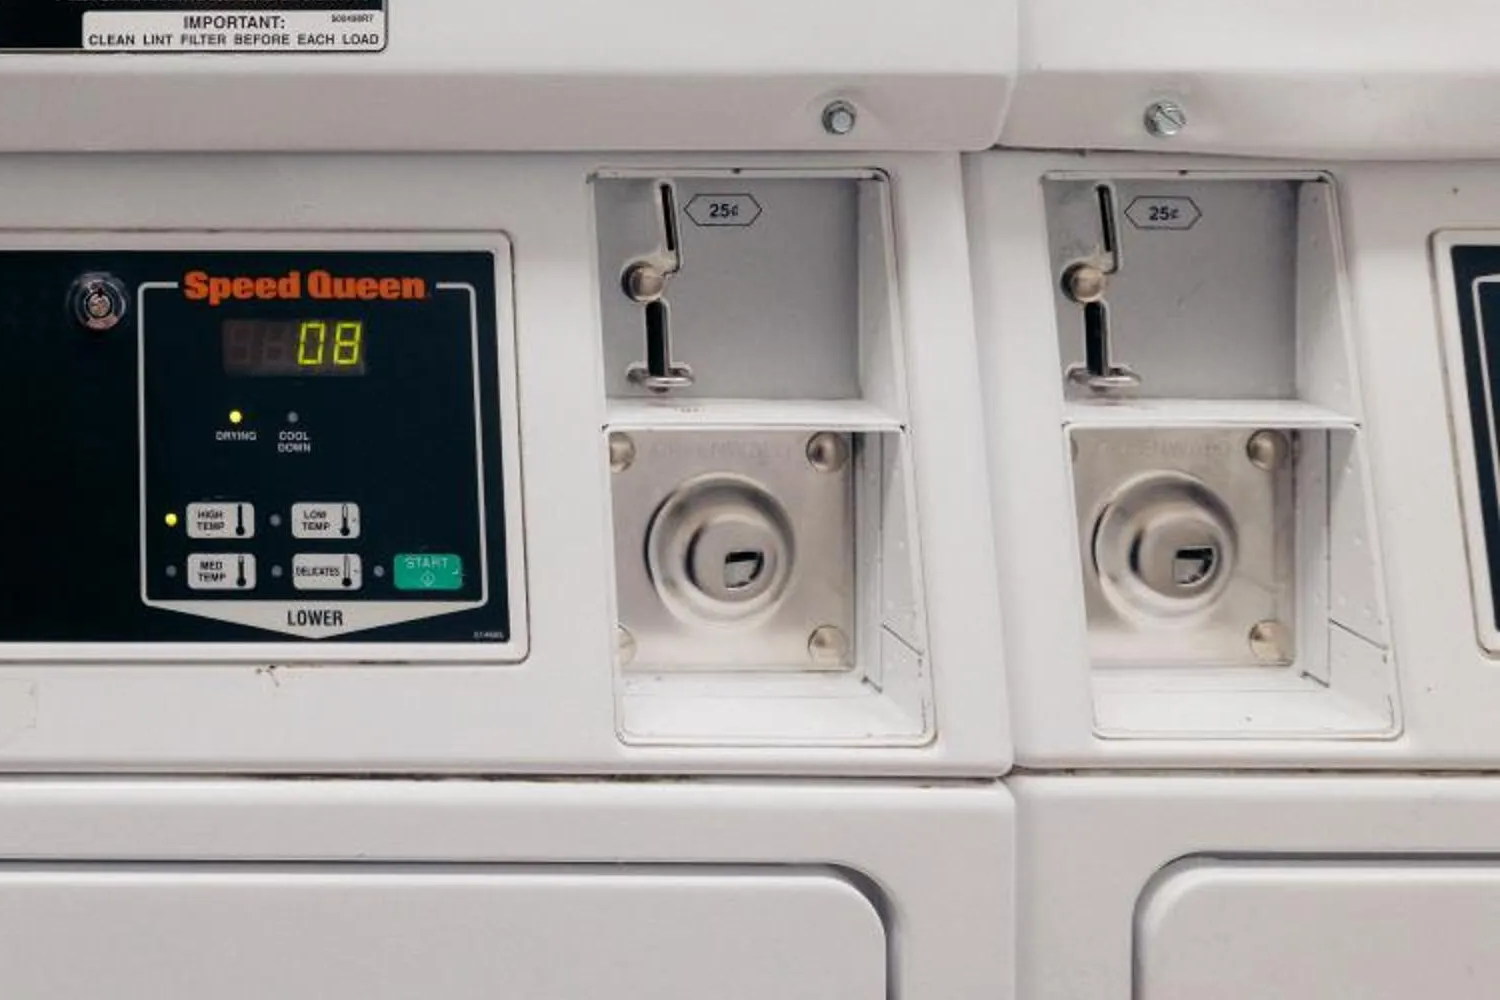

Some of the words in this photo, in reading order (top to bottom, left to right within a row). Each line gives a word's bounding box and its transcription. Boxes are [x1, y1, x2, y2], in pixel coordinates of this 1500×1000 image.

[184, 16, 286, 29] IMPORTANT:
[89, 34, 135, 46] CLEAN
[143, 34, 173, 46] LINT
[181, 34, 227, 46] FILTER
[235, 34, 290, 46] BEFORE
[298, 34, 335, 46] EACH
[343, 34, 379, 46] LOAD
[709, 203, 739, 218] 25¢
[1149, 206, 1179, 221] 25¢
[184, 270, 301, 306] Speed
[308, 270, 425, 299] Queen
[298, 321, 363, 366] 08
[216, 431, 257, 441] DRYING
[279, 431, 310, 441] COOL
[278, 443, 311, 453] DOWN
[197, 510, 224, 520] HIGH
[303, 510, 327, 520] LOW
[196, 522, 225, 531] TEMP
[302, 522, 330, 531] TEMP
[199, 561, 223, 570] MED
[406, 557, 448, 568] START
[198, 572, 226, 582] TEMP
[296, 567, 340, 577] DELICATES
[288, 611, 343, 626] LOWER
